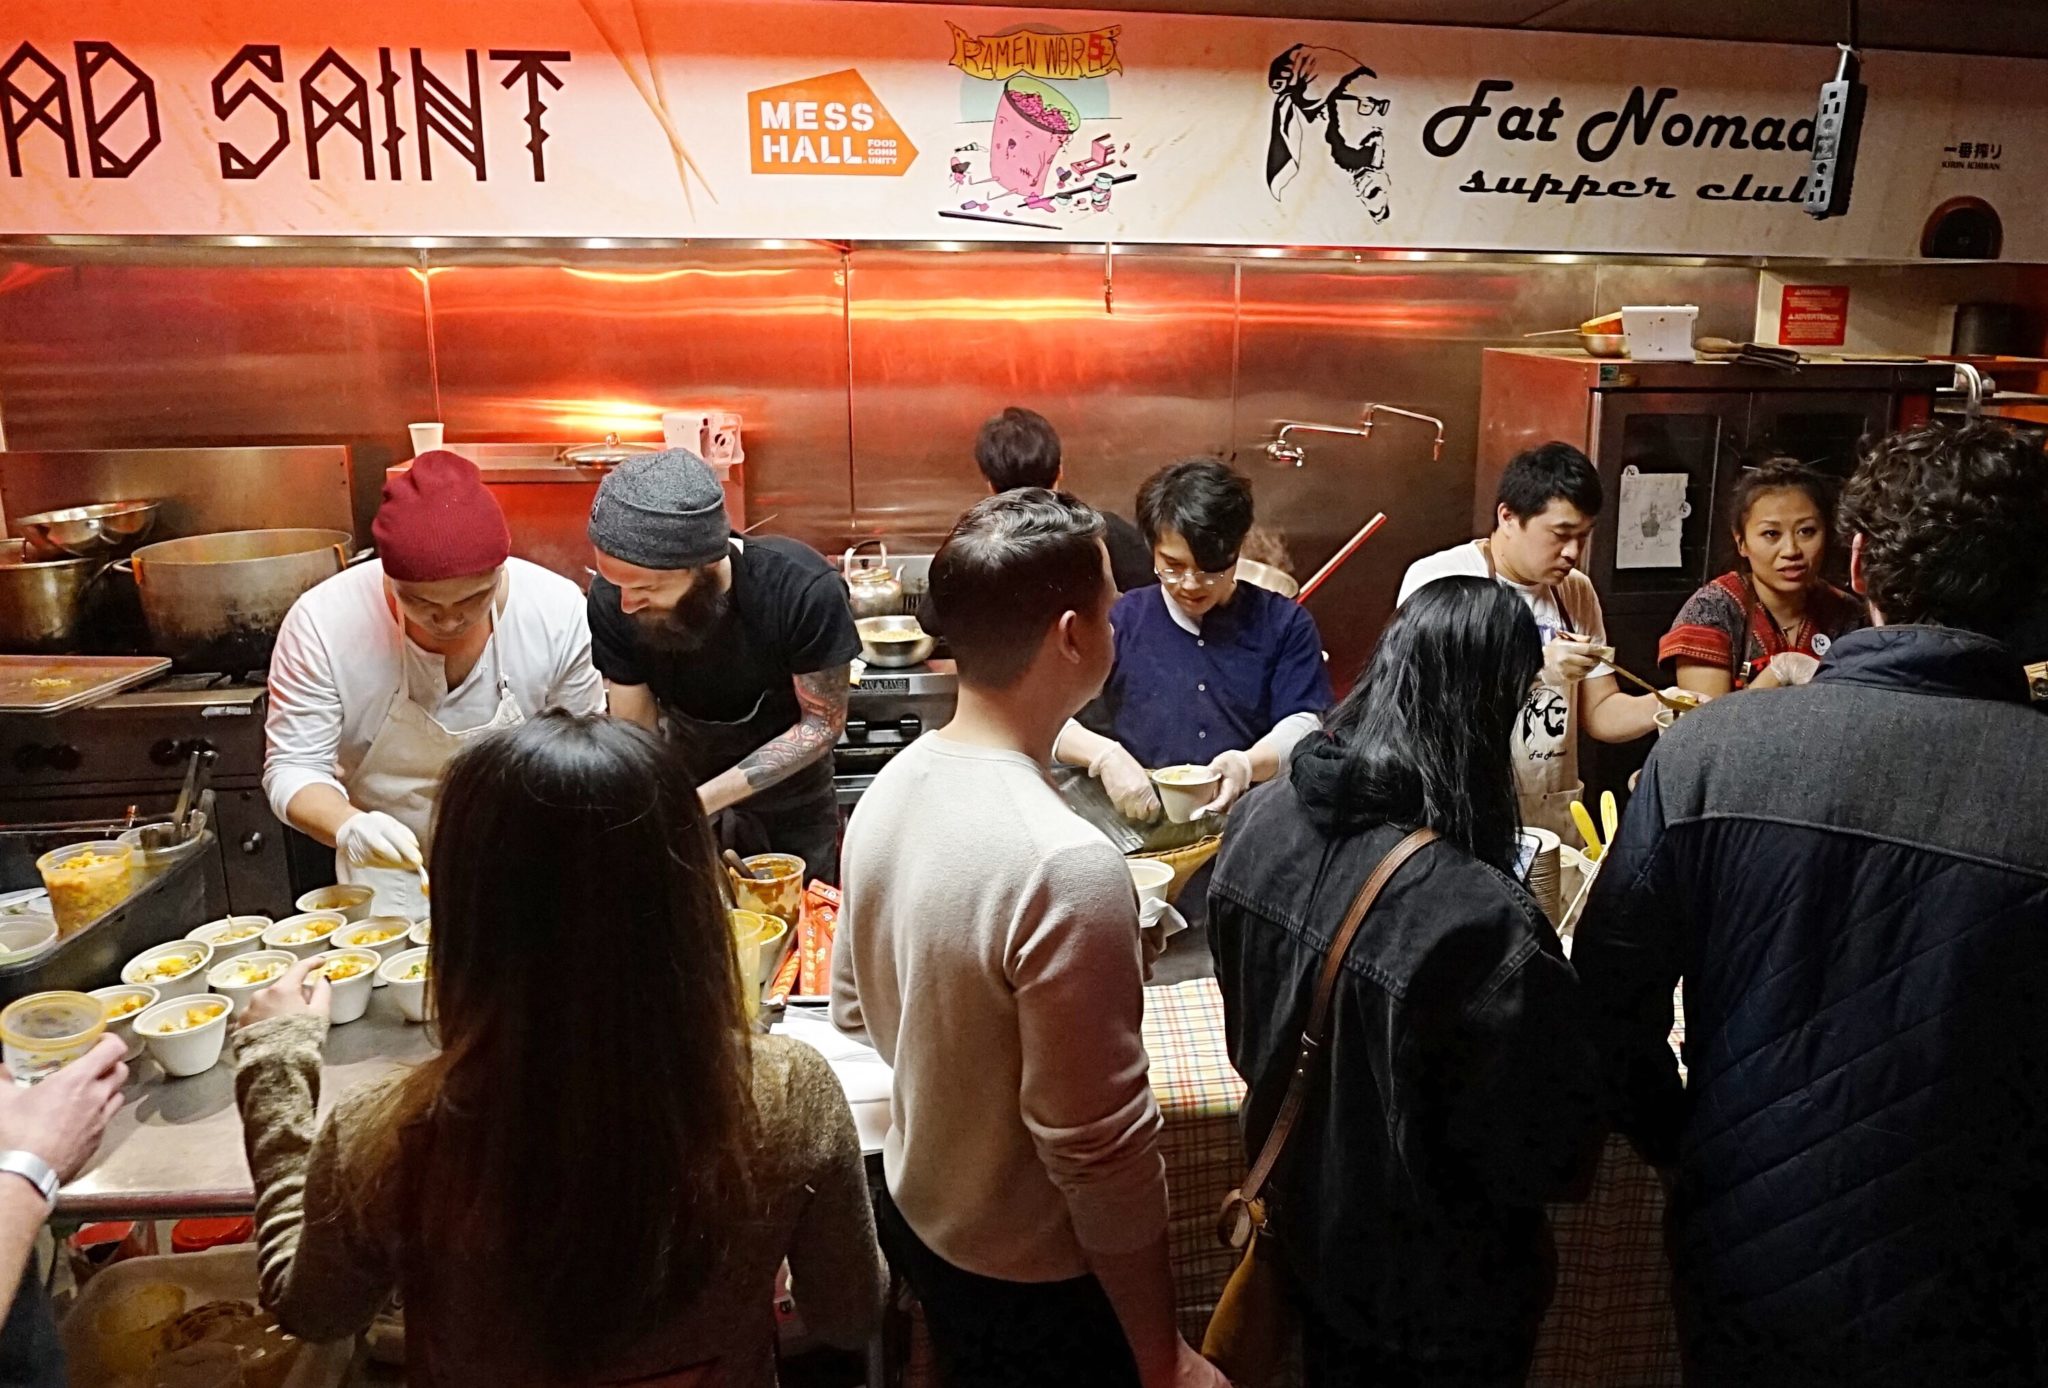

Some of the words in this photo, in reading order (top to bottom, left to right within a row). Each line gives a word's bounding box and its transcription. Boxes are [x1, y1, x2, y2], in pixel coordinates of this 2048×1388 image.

[963, 36, 1037, 74] RAMEN
[211, 43, 571, 182] SAINT
[760, 101, 875, 132] MESS
[1423, 79, 1564, 158] Fat
[867, 138, 897, 148] FOOD
[867, 148, 897, 157] COMM
[867, 156, 897, 165] UNITY
[1459, 169, 1677, 204] supper
